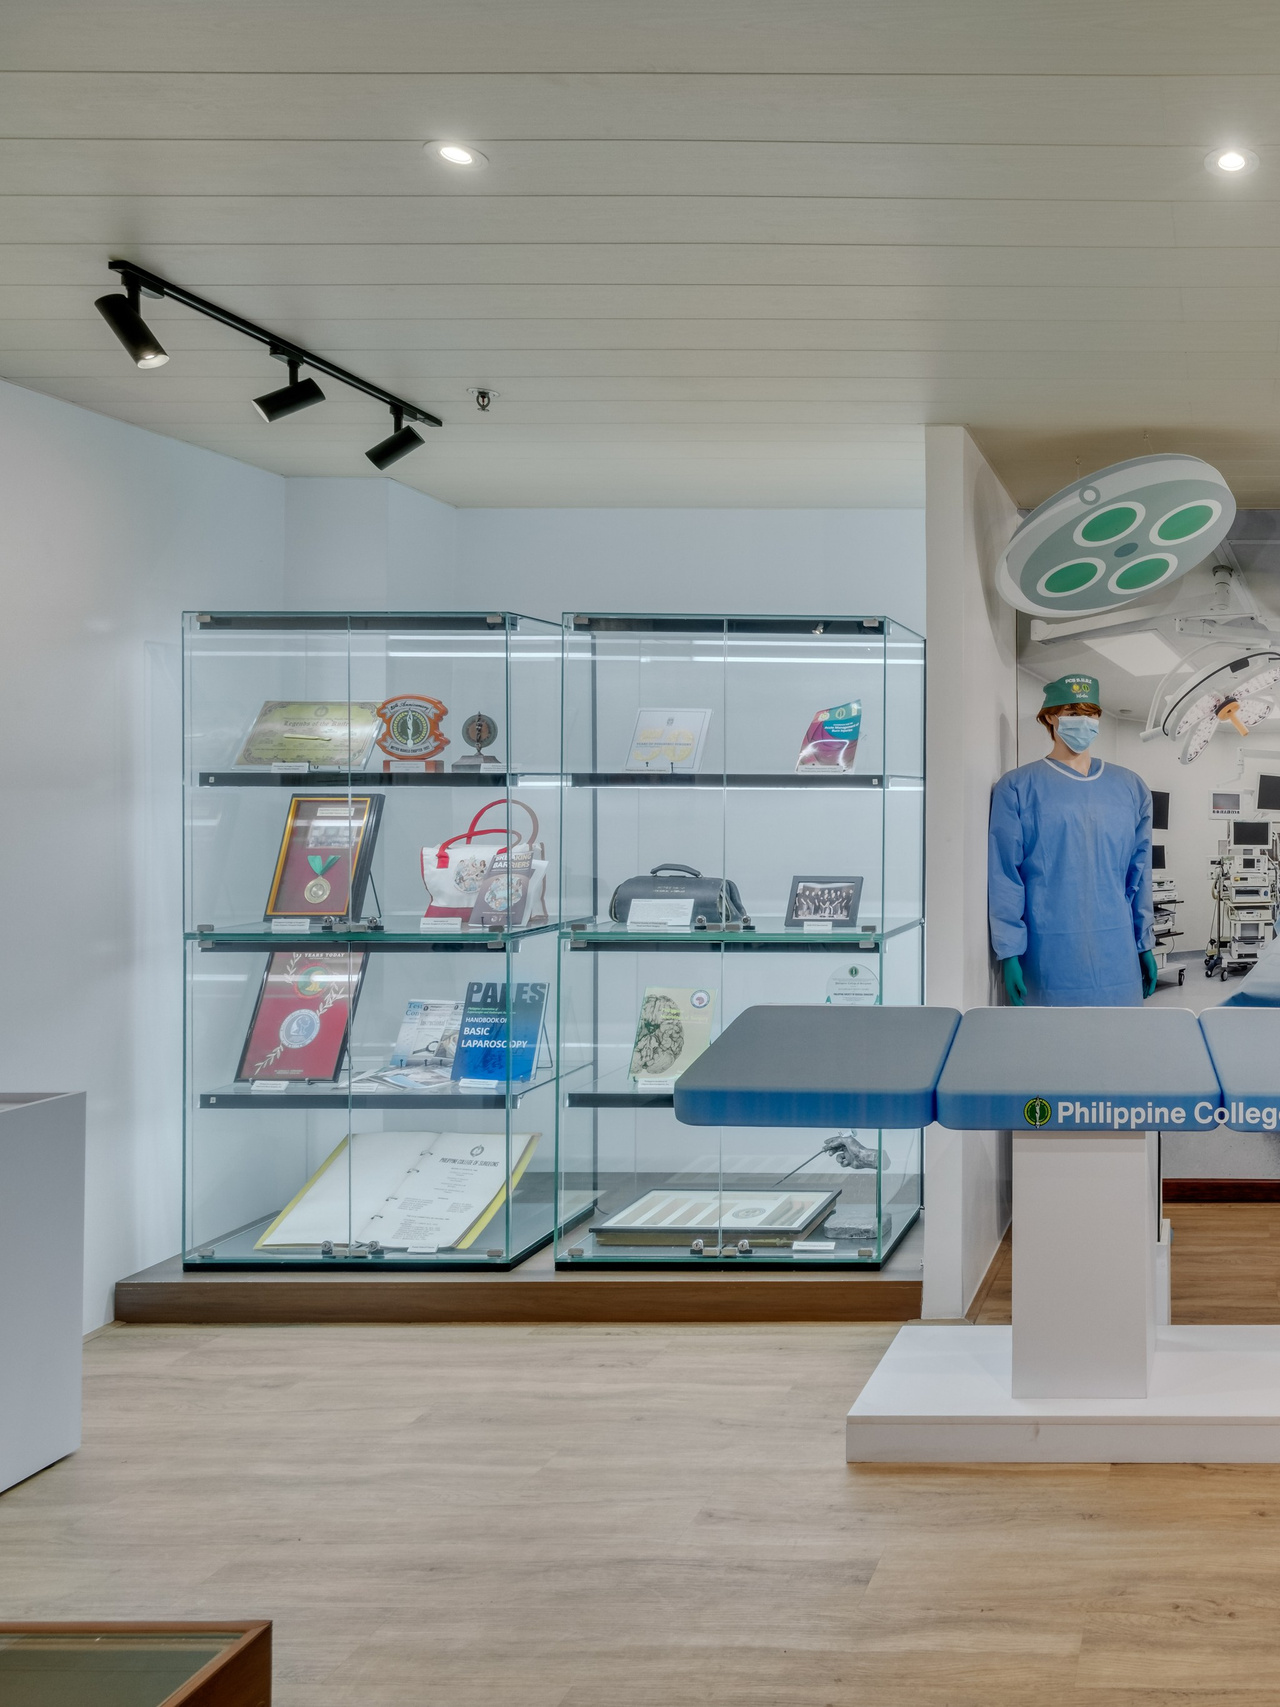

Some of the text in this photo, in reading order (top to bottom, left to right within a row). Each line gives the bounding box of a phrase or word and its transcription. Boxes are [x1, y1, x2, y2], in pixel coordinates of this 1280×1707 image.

[633, 728, 695, 762] 50
[495, 853, 532, 861] BREKING
[463, 1027, 490, 1035] BASIC
[461, 1040, 528, 1048] LAPAROSCOPY
[1058, 1102, 1186, 1129] Philippine
